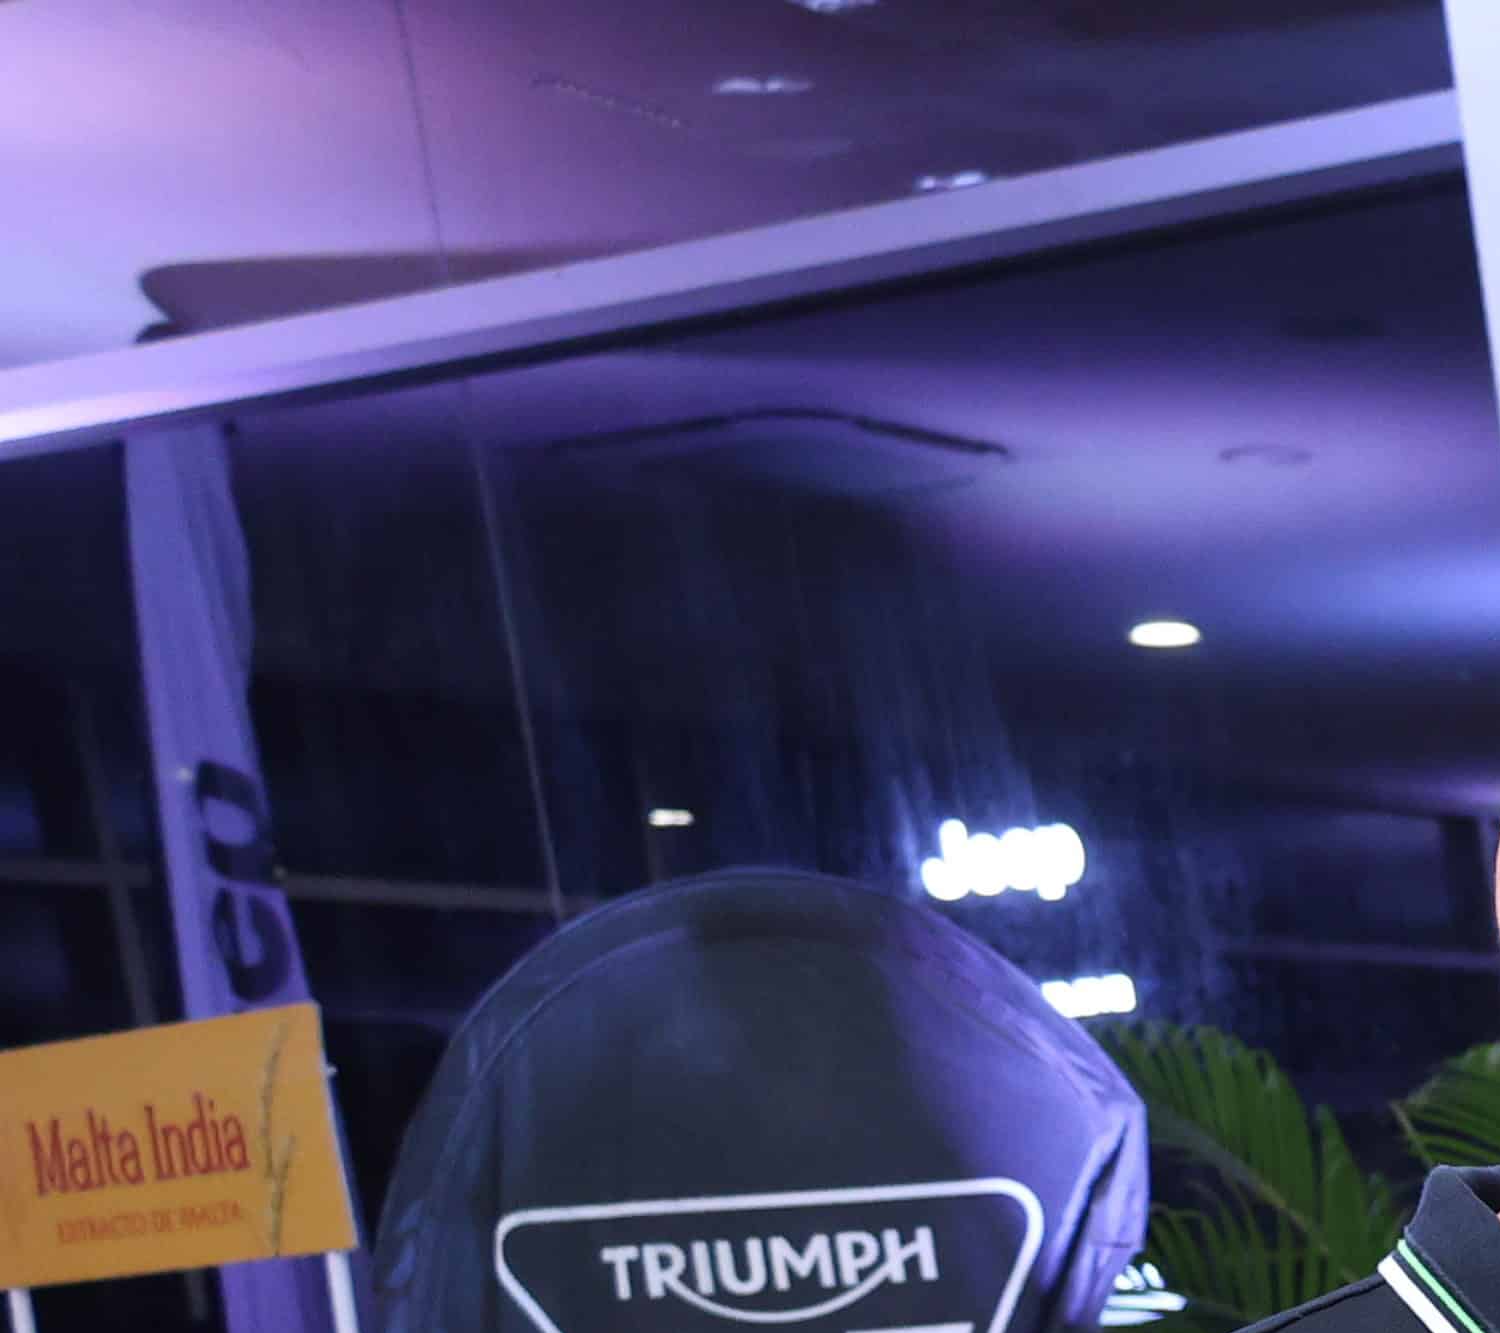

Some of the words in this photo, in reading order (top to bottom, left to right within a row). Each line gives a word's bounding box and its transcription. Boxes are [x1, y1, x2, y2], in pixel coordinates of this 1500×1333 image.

[25, 1107, 146, 1197] Malta
[143, 1090, 251, 1182] India
[600, 1225, 940, 1320] TRIUMPH
